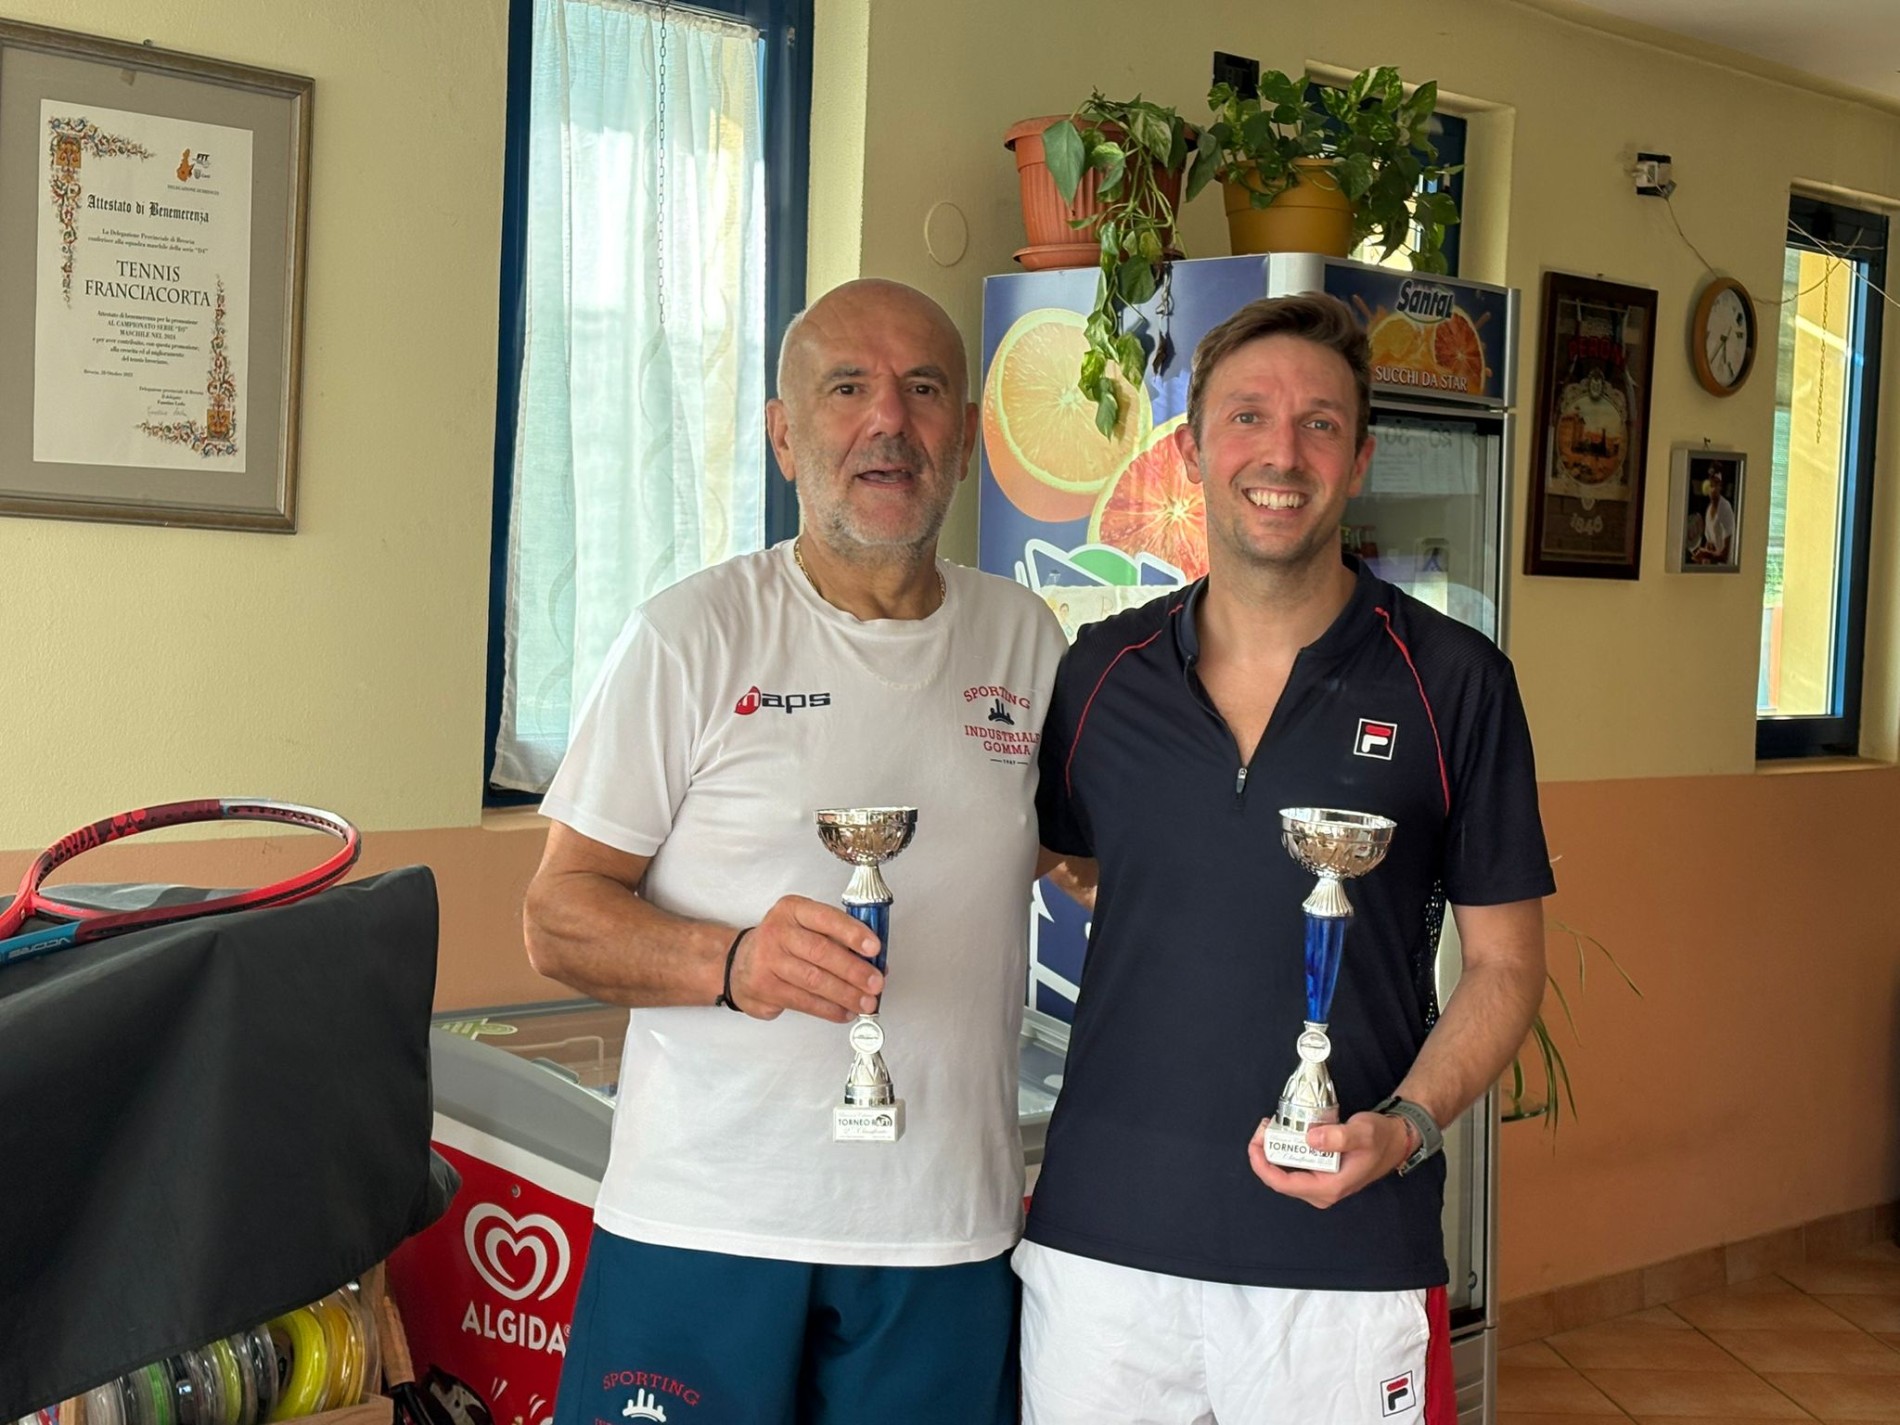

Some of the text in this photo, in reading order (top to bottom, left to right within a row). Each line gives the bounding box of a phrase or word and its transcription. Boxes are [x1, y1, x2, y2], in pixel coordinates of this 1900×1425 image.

[86, 194, 210, 225] Attestato di Benemerenza
[116, 259, 181, 283] TENNIS
[84, 279, 211, 307] FRANCIACORTA
[1375, 365, 1467, 391] SUCCHI DA STAR
[963, 685, 1031, 710] SPORTING
[983, 740, 1031, 755] GOMMA
[838, 1118, 870, 1126] TORNEO
[1268, 1141, 1307, 1154] TORNEO
[461, 1299, 567, 1359] ALGIDA
[602, 1370, 701, 1407] SPORTING
